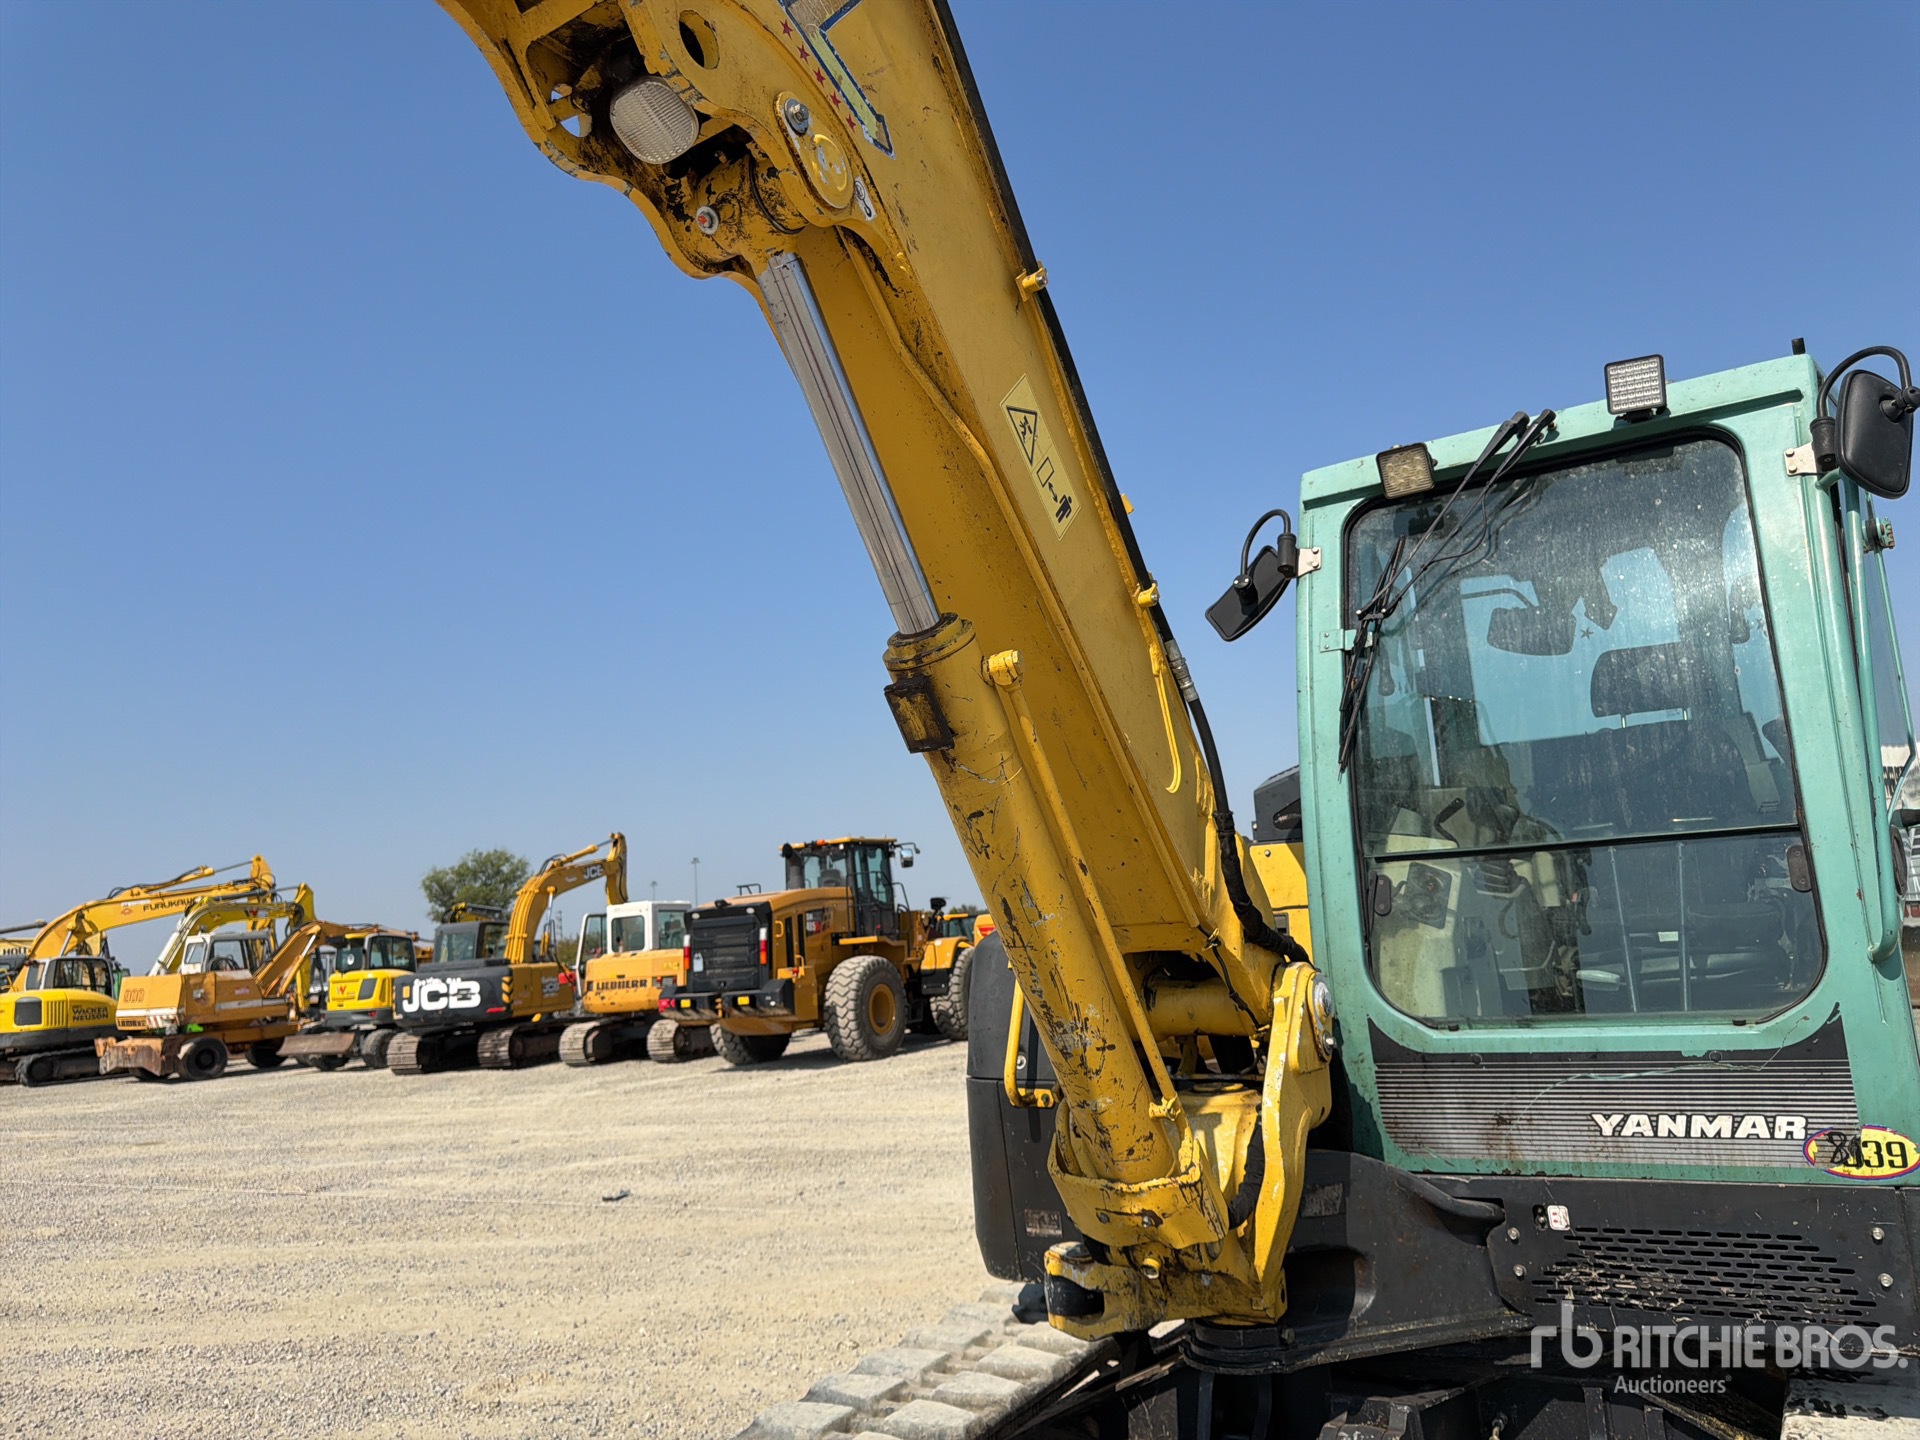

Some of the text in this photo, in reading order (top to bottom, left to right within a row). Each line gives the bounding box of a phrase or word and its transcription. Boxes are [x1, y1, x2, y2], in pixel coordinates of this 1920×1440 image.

[596, 979, 647, 991] LIEBHERR
[402, 979, 481, 1013] JCB
[72, 1006, 109, 1016] WACKER
[72, 1013, 109, 1022] NEUSON
[1590, 1113, 1807, 1140] YANMAR
